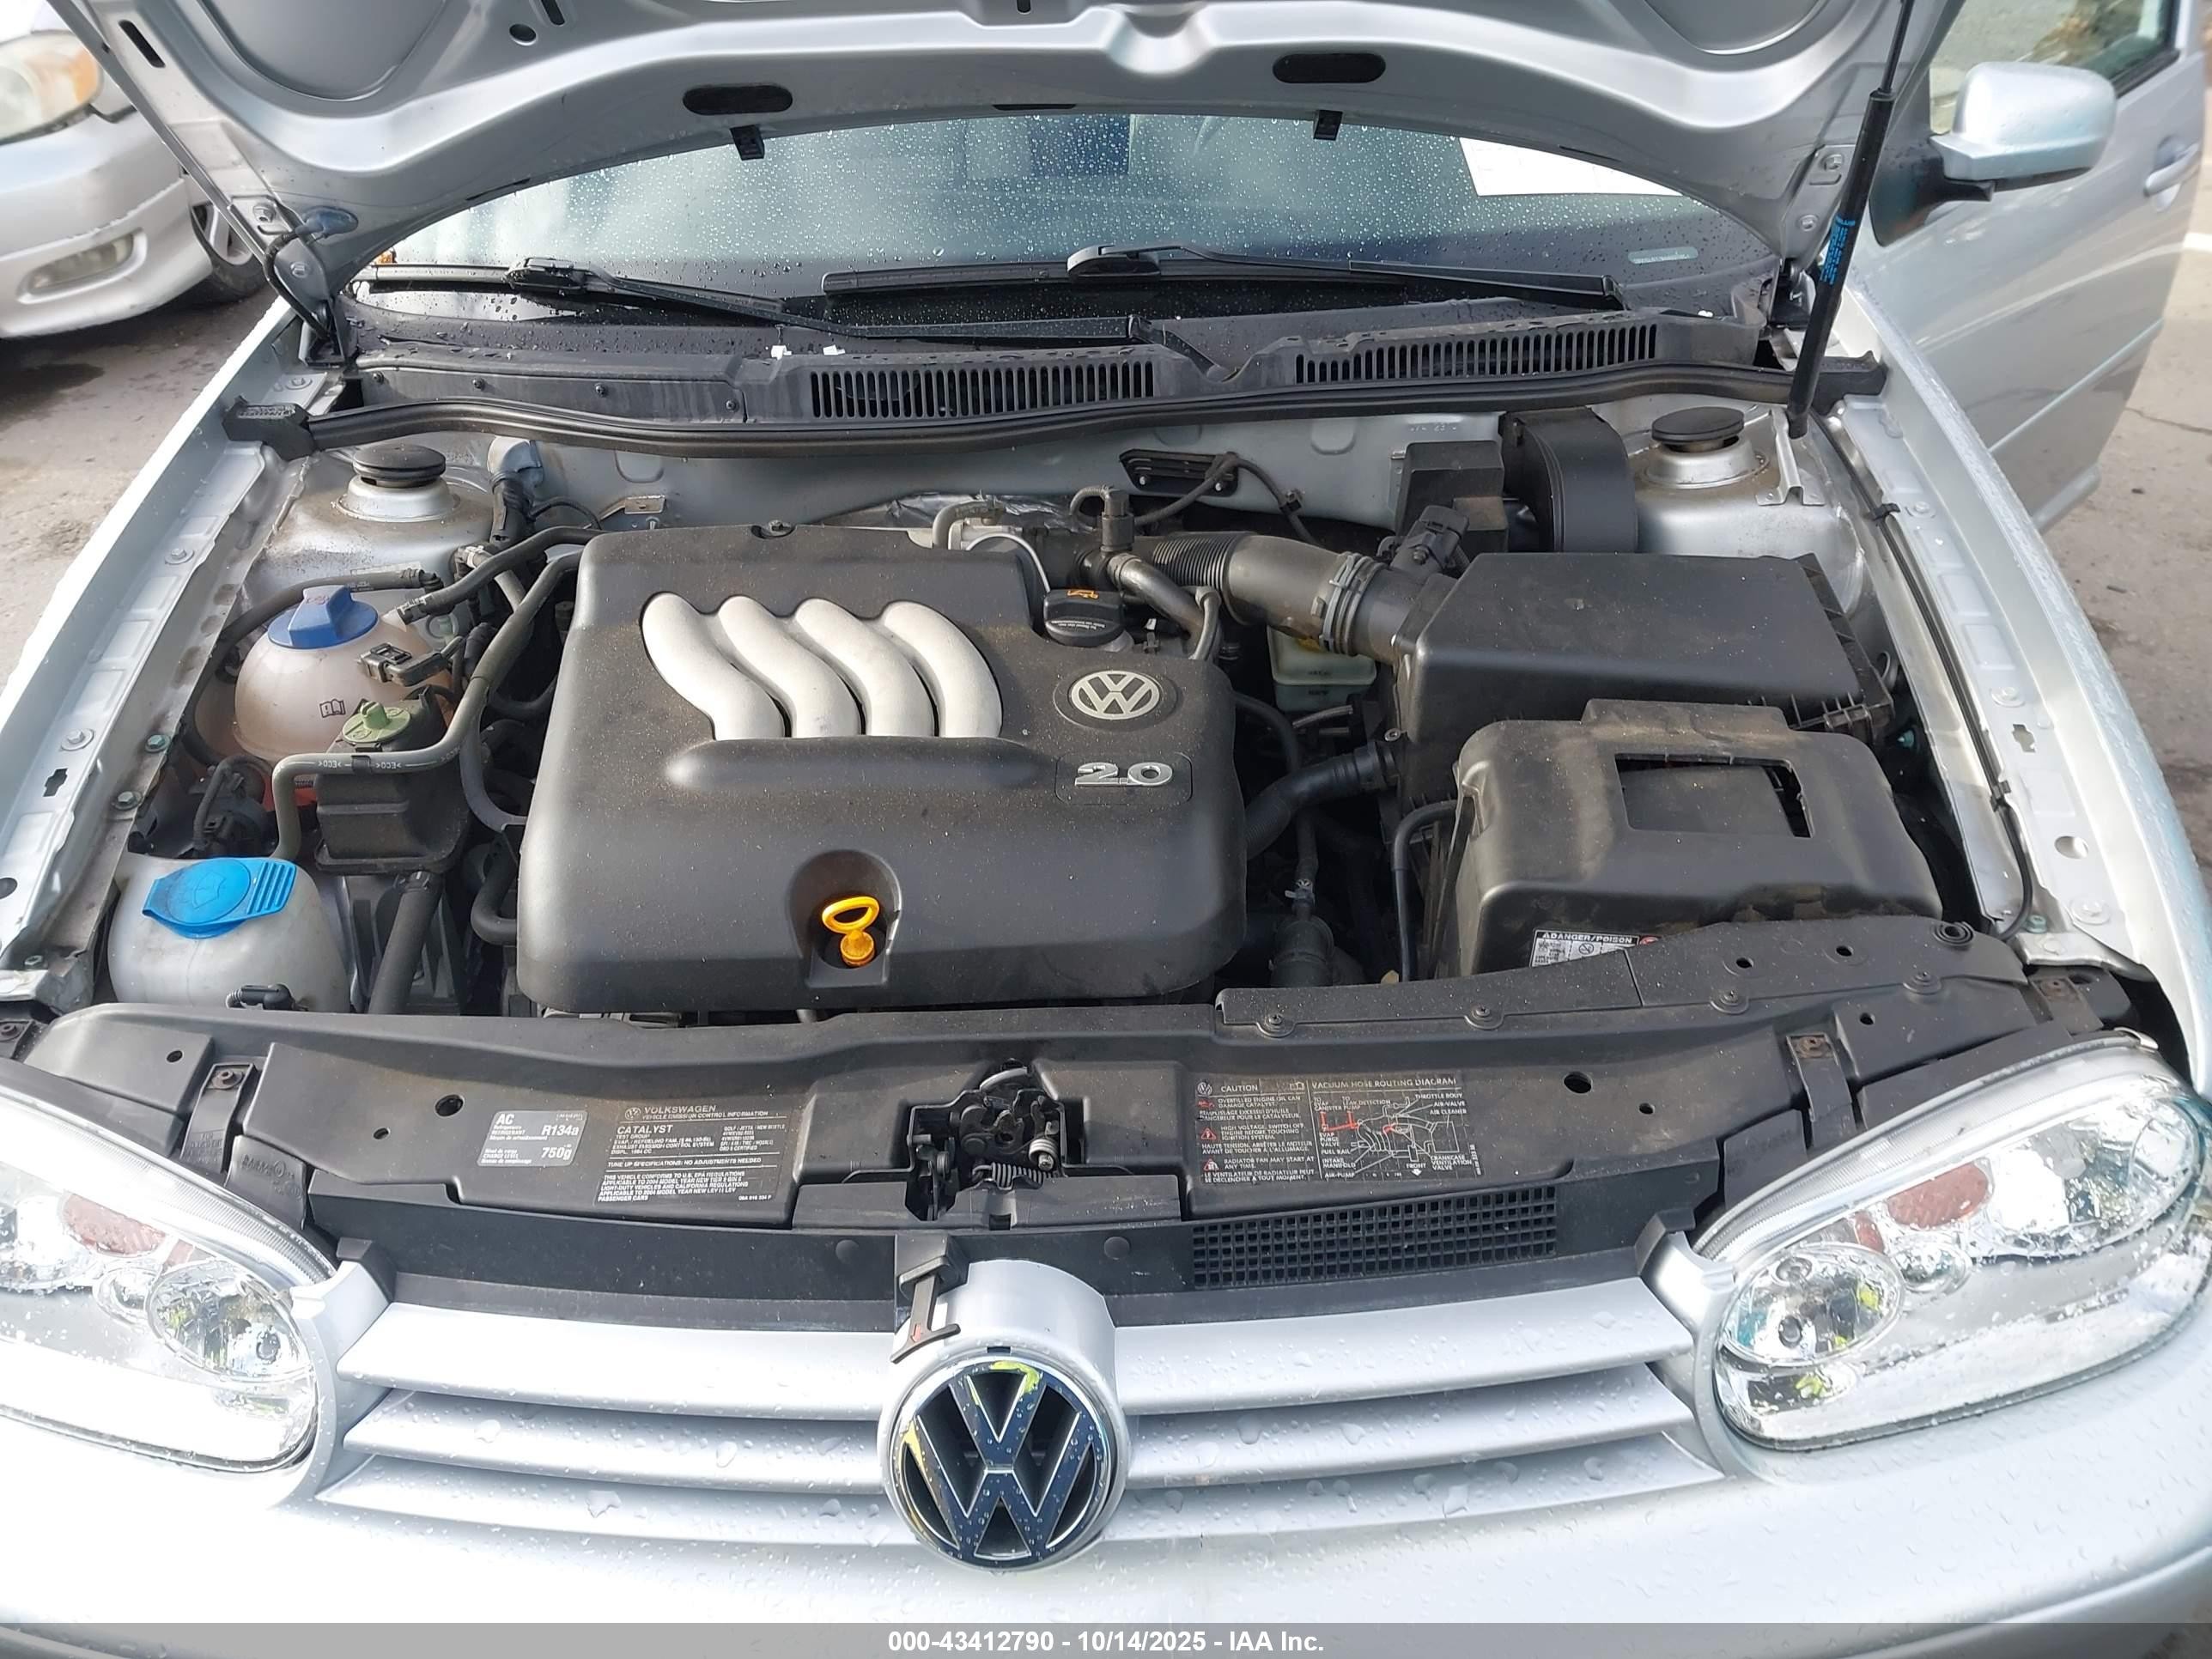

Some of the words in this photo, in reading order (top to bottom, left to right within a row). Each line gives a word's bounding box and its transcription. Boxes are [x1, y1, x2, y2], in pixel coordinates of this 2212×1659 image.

[1312, 1081, 1348, 1090] VACUUM
[1415, 1078, 1456, 1086] DIAGRAM
[644, 1105, 717, 1114] VOLKSWAGEN
[495, 1114, 515, 1125] AC
[541, 1125, 580, 1136] R134a
[617, 1124, 673, 1133] CATALYST
[541, 1146, 573, 1161] 750g
